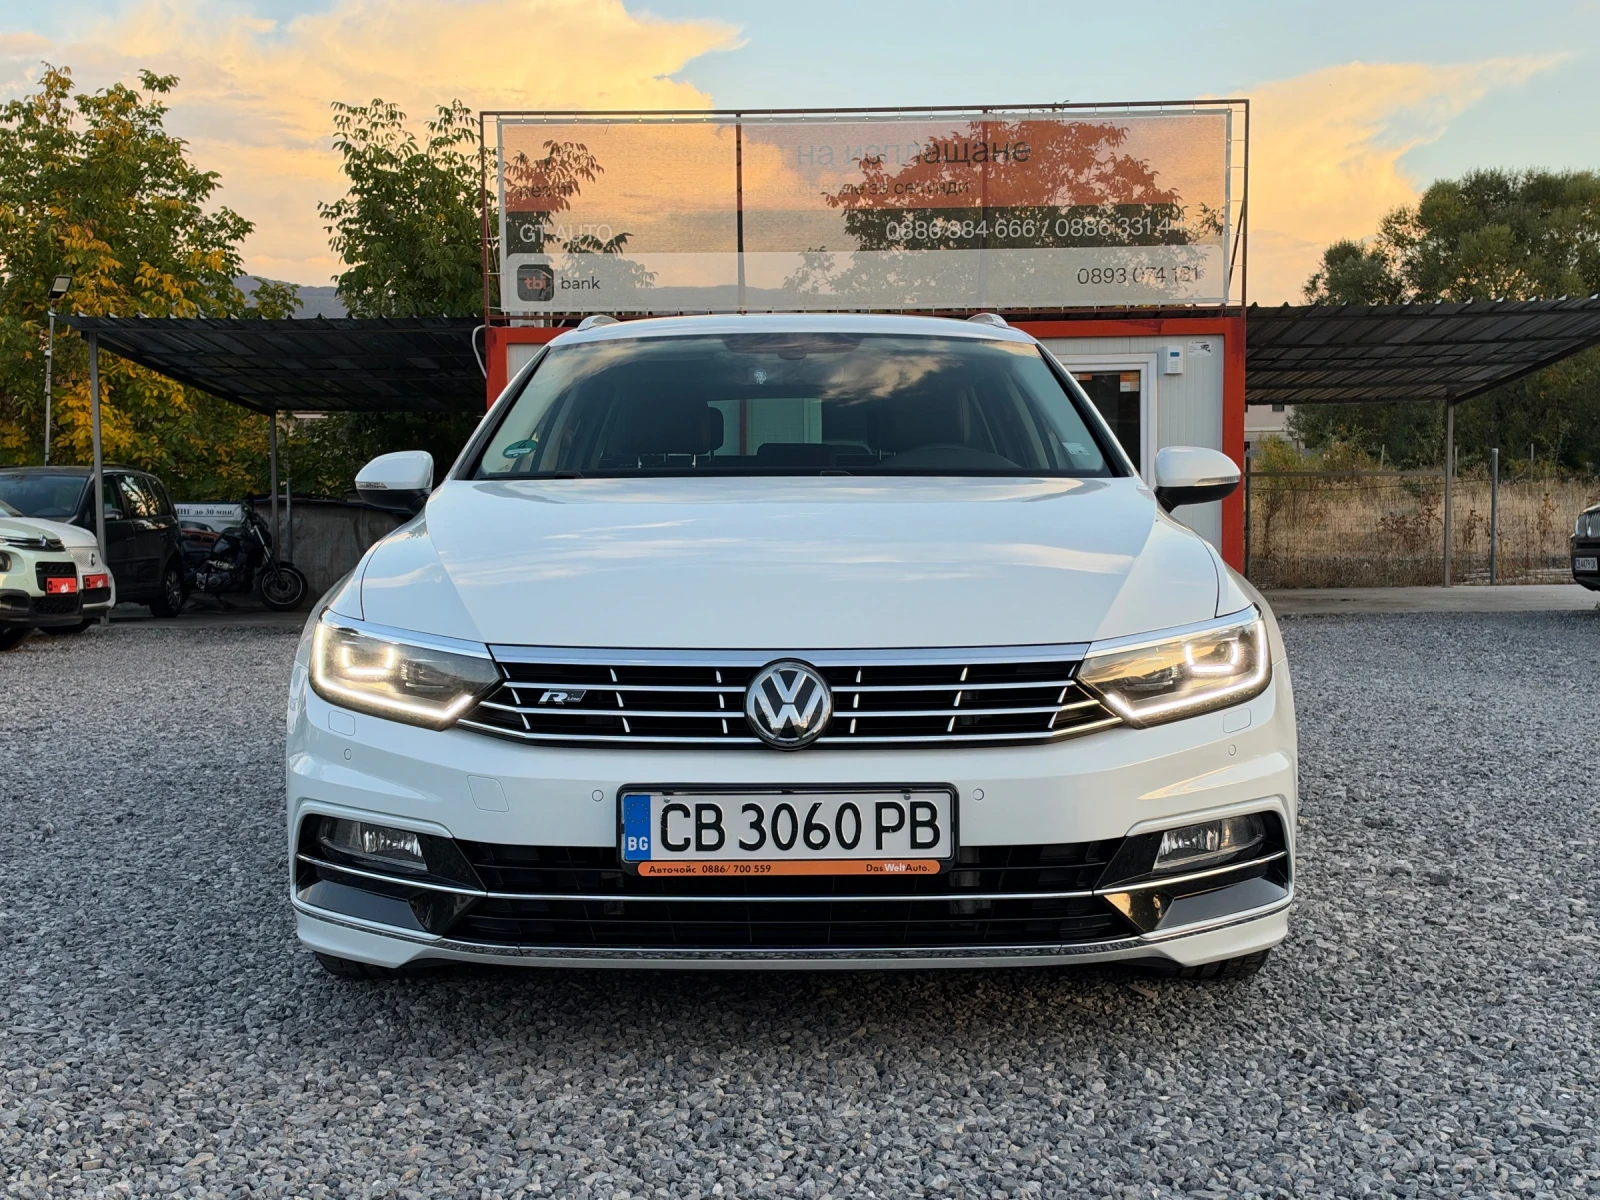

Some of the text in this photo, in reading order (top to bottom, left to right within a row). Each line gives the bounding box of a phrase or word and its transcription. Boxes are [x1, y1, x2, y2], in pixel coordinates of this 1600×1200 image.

[520, 223, 613, 243] GT AUTO
[886, 220, 941, 240] 0886
[949, 219, 990, 239] 884
[994, 218, 1036, 239] 666
[1055, 218, 1111, 237] 0886
[1117, 216, 1152, 236] 331
[524, 275, 601, 291] tbi bank
[1077, 266, 1127, 285] 0893
[660, 800, 941, 852] CB 3060 PB
[627, 836, 649, 851] BG
[648, 865, 697, 874] Авточойс
[733, 864, 751, 873] 700
[754, 864, 772, 873] 559
